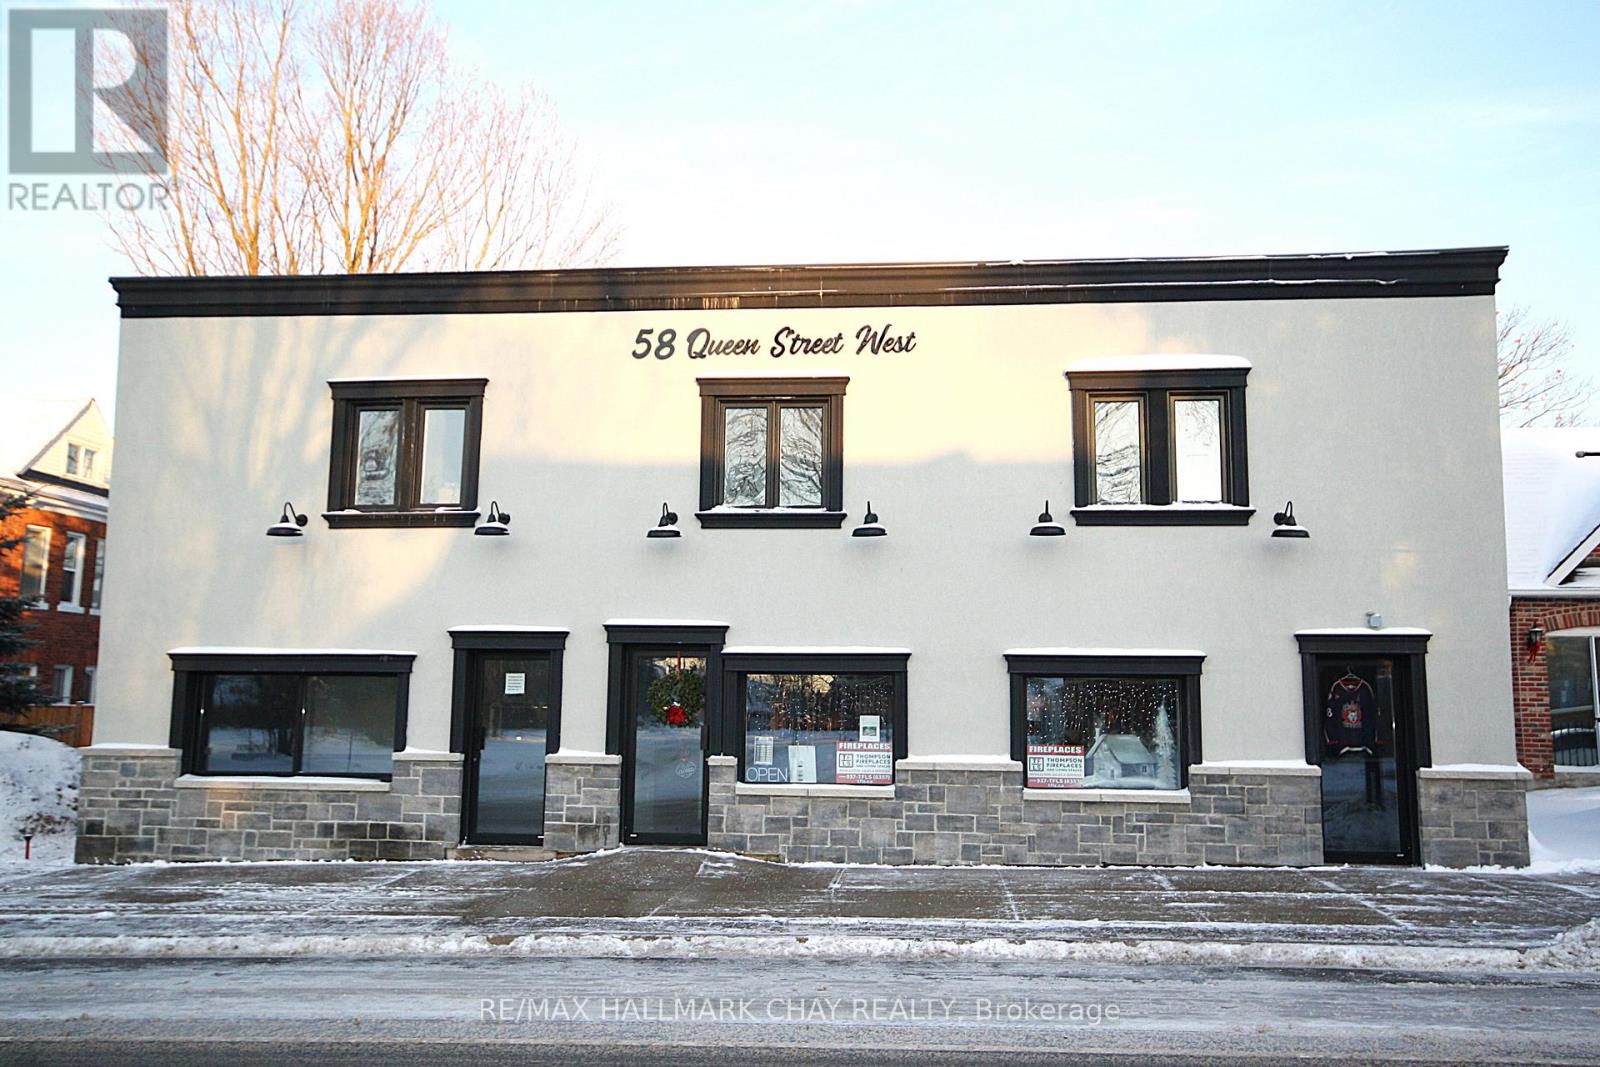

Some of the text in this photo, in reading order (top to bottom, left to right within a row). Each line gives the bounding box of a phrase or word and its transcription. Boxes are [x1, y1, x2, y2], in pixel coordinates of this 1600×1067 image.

[631, 323, 917, 360] 58 Queen Street West
[839, 742, 890, 750] FIREPLACES
[1029, 745, 1081, 753] FIREPLACES
[746, 767, 788, 782] OPEN
